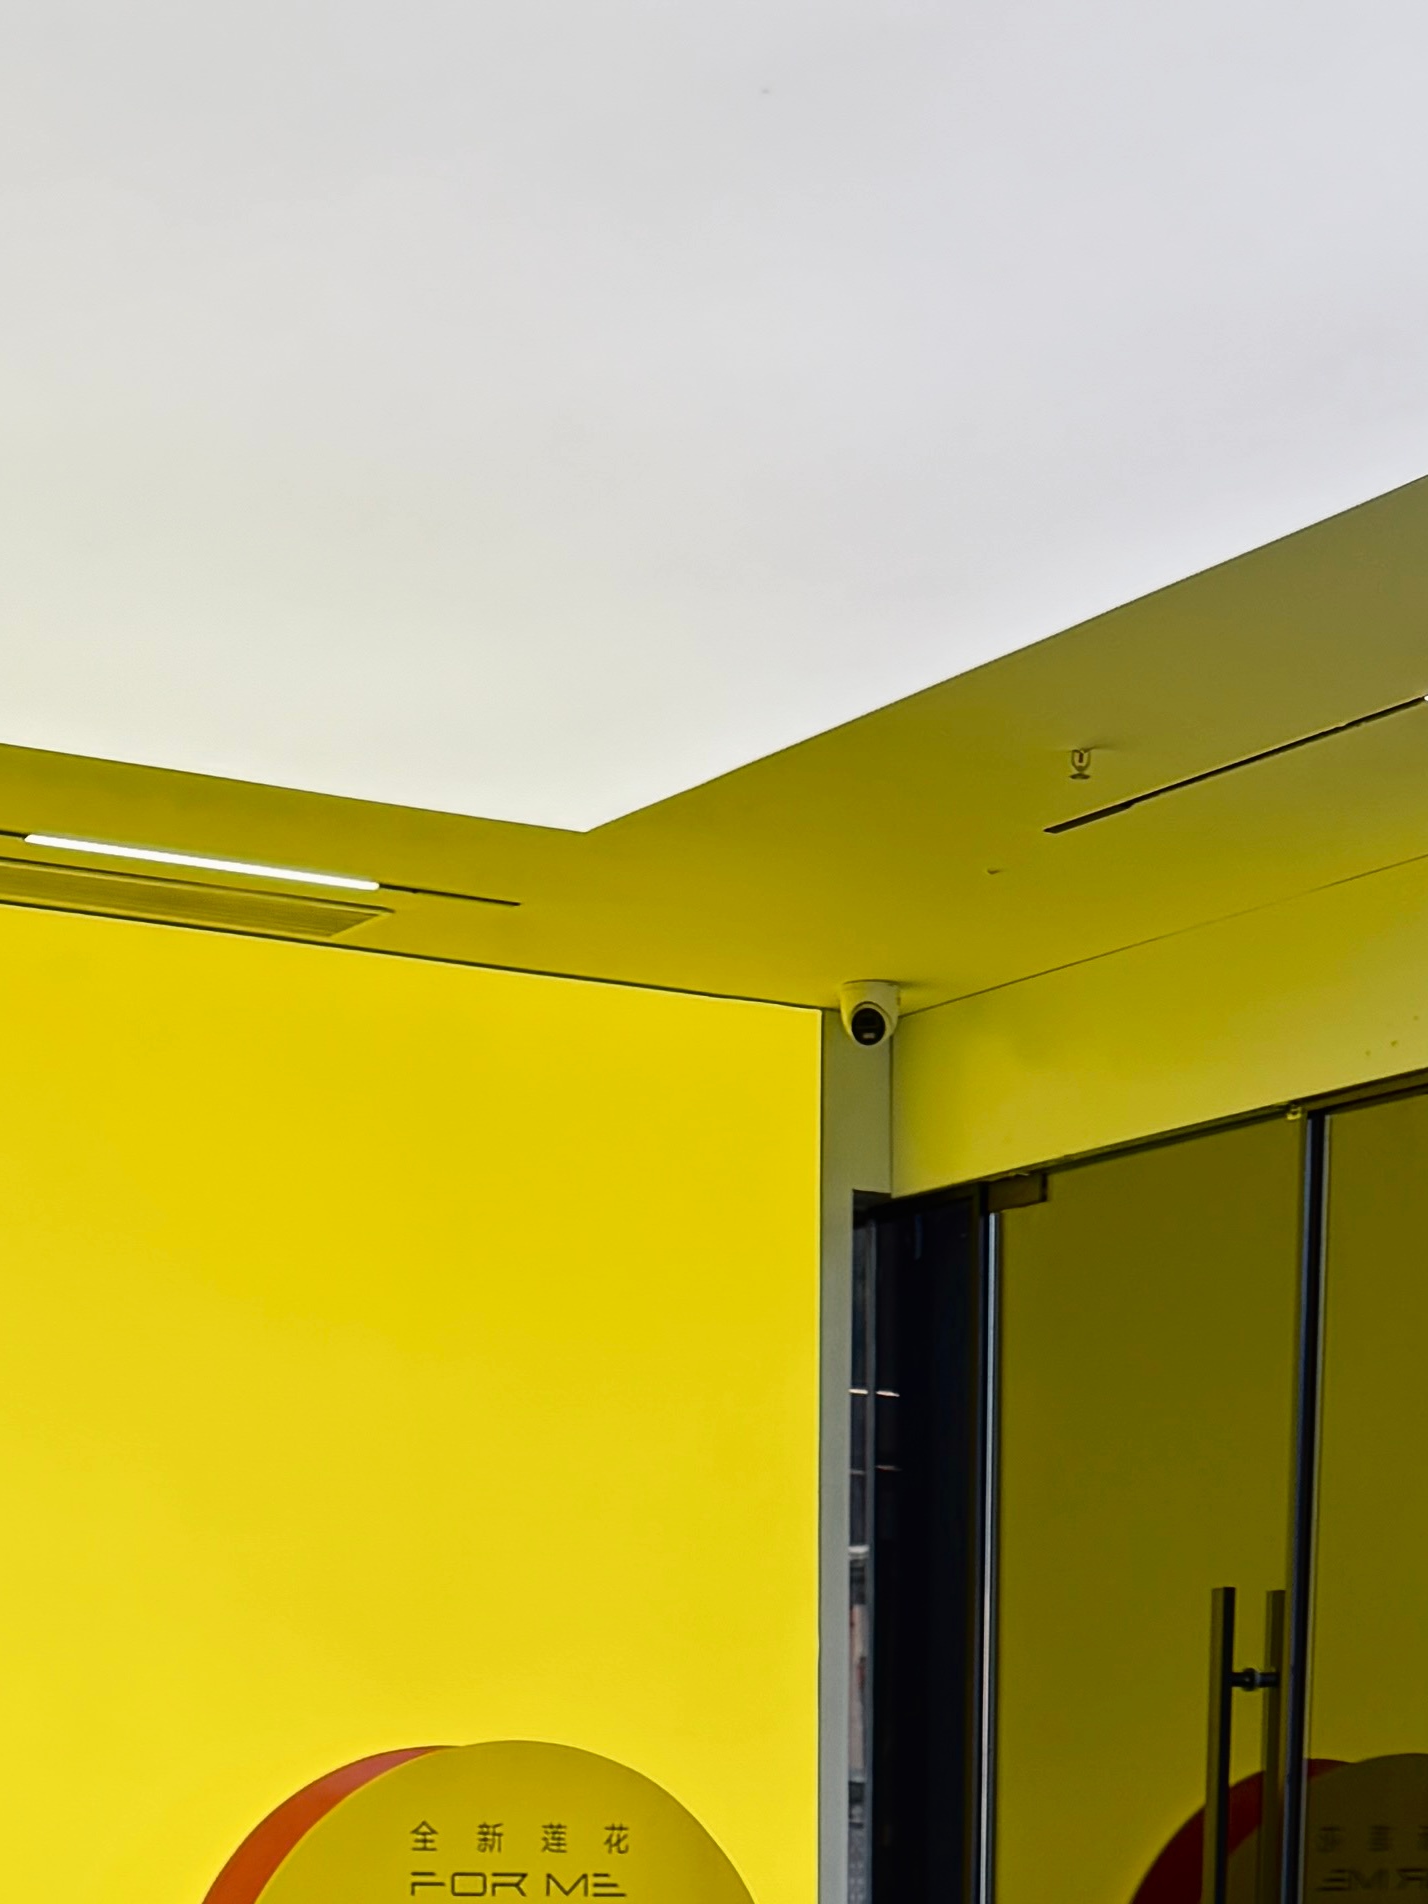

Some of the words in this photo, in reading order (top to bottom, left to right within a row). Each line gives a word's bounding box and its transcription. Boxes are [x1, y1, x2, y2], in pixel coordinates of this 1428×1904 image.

[410, 1820, 630, 1856] 全新莲花
[410, 1871, 528, 1898] FOR
[545, 1871, 628, 1899] ME
